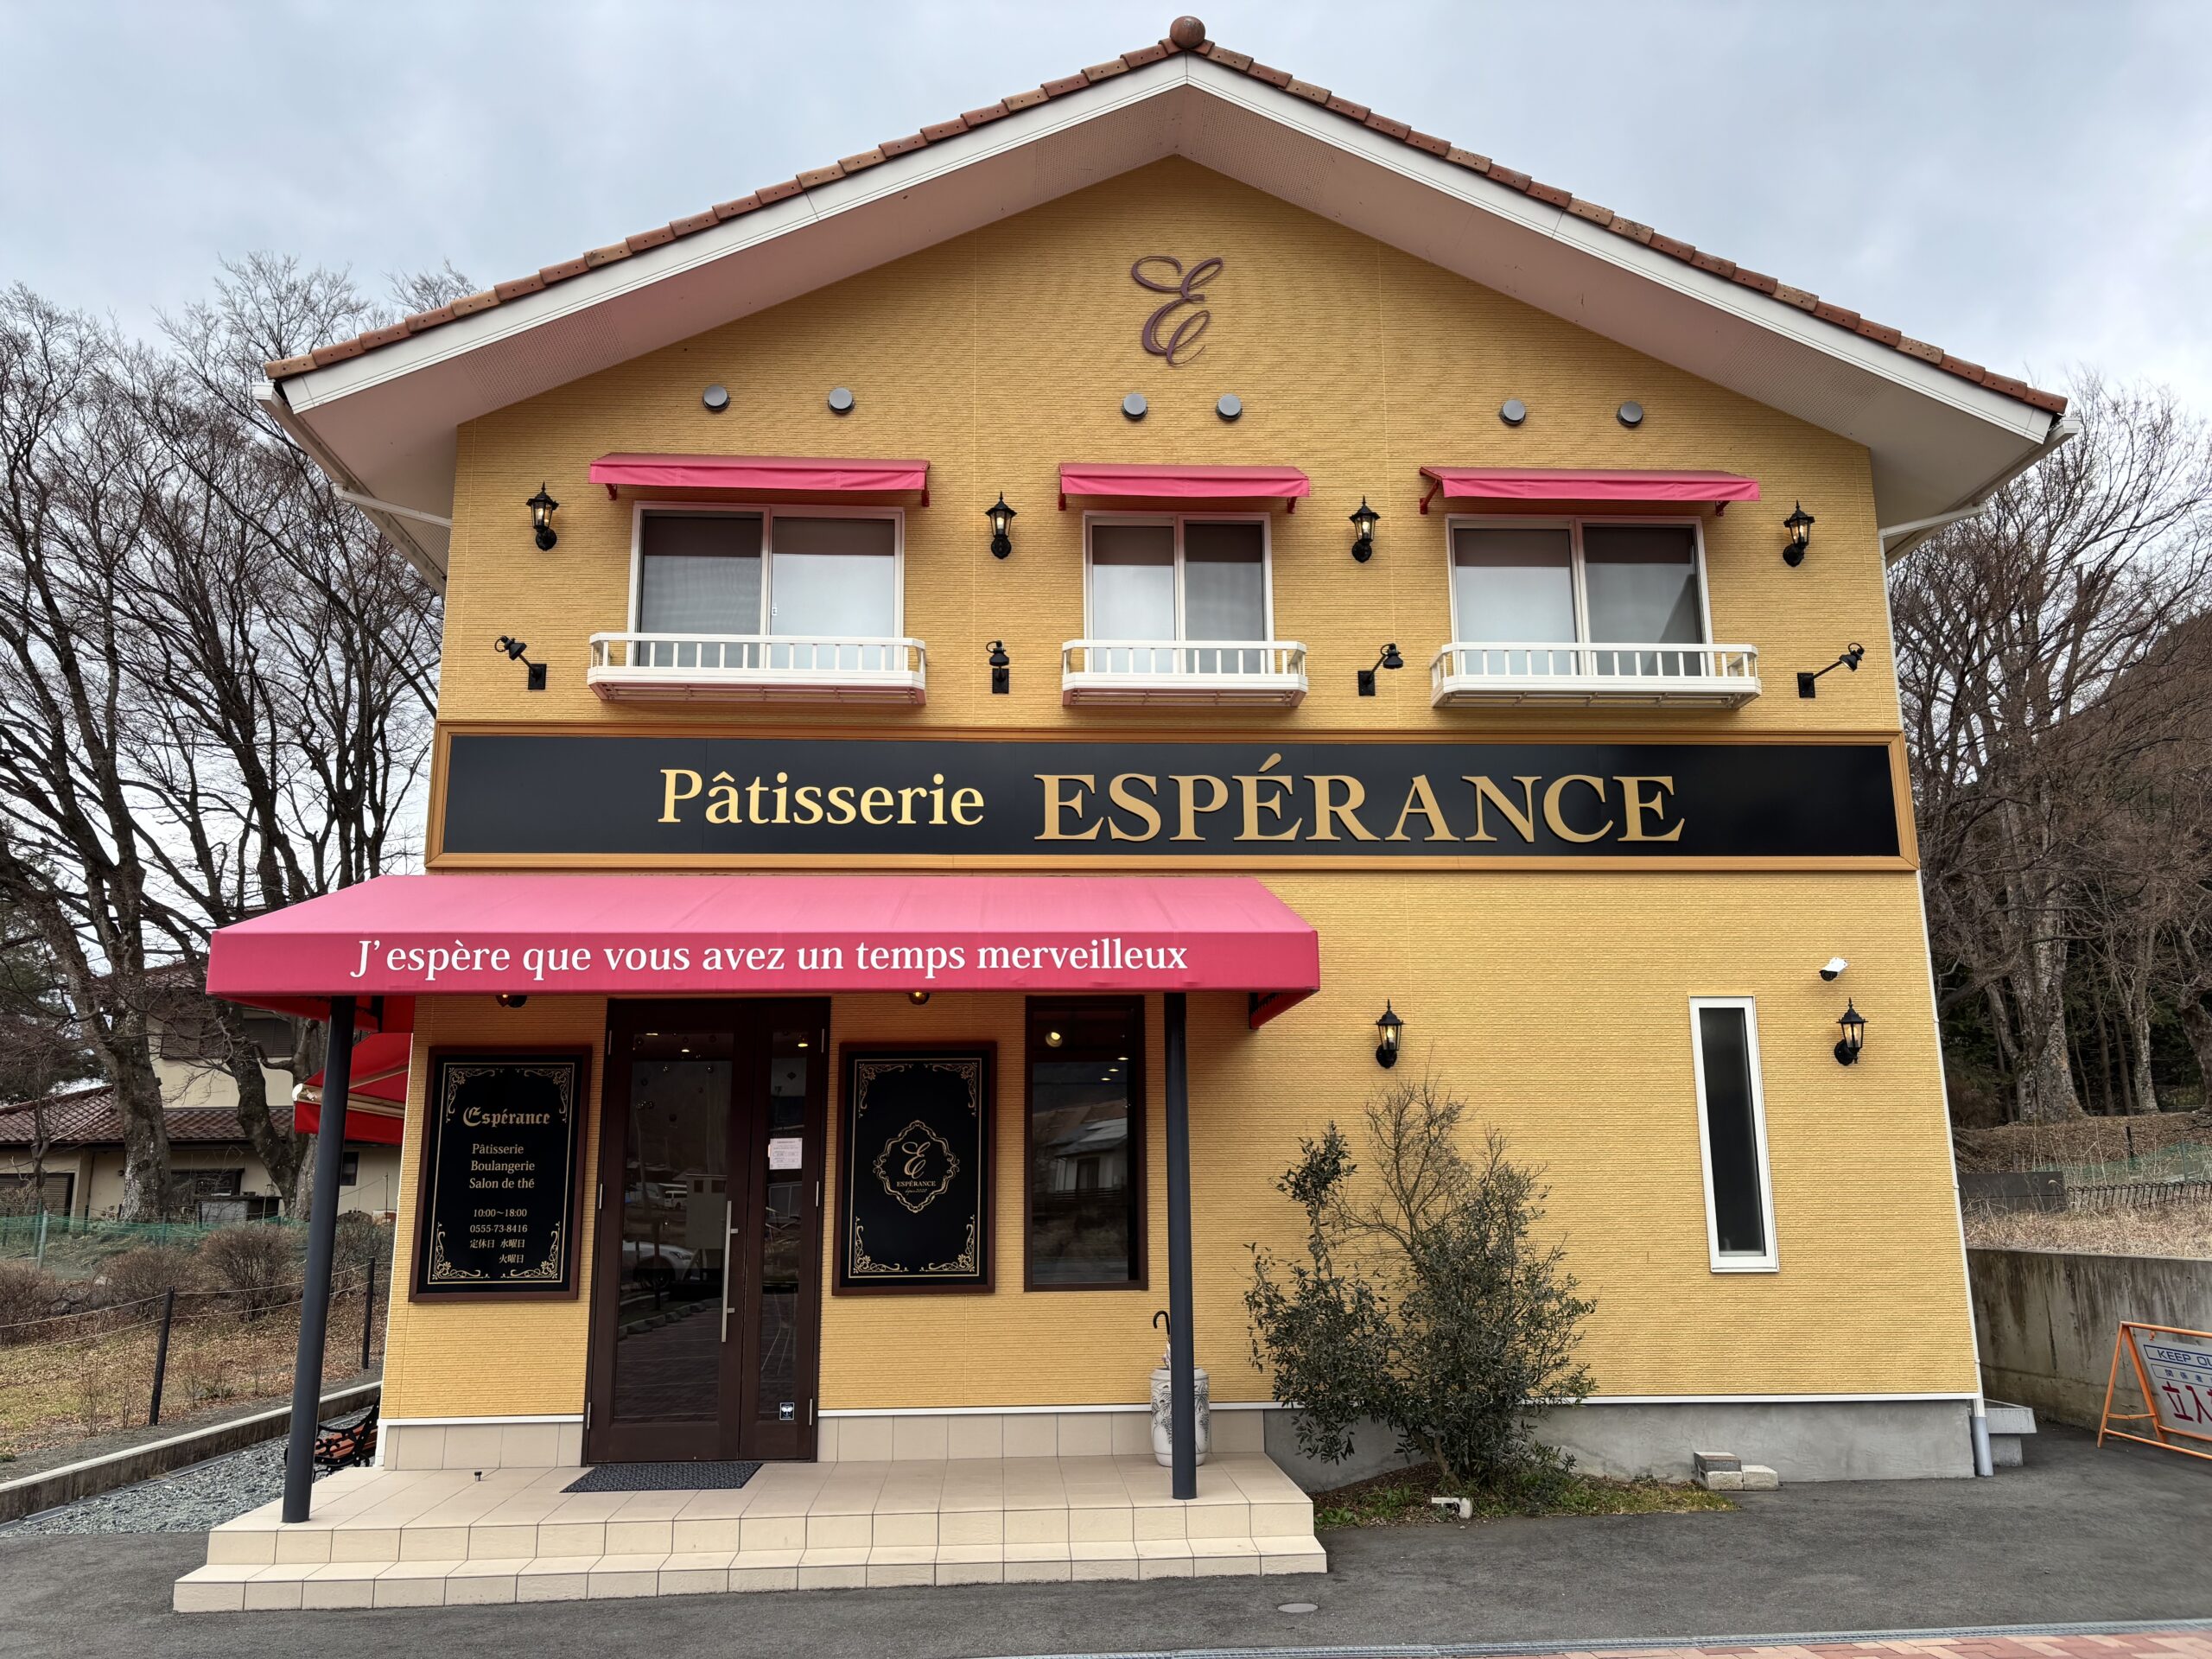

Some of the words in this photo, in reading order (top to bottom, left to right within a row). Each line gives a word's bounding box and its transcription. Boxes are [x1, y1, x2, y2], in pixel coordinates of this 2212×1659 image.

[1131, 255, 1224, 367] E
[658, 768, 985, 825] Pâtisserie
[1034, 753, 1686, 843] ESPÉRANCE
[522, 947, 592, 981] que
[603, 946, 690, 971] vous
[702, 945, 785, 971] avez
[798, 946, 844, 970] un
[855, 941, 966, 979] temps
[976, 938, 1188, 970] merveilleux
[462, 1106, 551, 1128] Espérance
[471, 1143, 524, 1155] Pâtisserie
[470, 1160, 536, 1174] Boulangerie
[468, 1177, 499, 1190] Salon
[501, 1177, 515, 1190] de
[517, 1177, 536, 1190] thé
[469, 1224, 529, 1234] 0555-73-8416
[469, 1238, 496, 1249] 定休日
[499, 1238, 525, 1249] 水曜日
[499, 1254, 525, 1264] 火曜日
[2157, 1349, 2192, 1363] KEEP
[2164, 1369, 2212, 1383] 関係者
[2162, 1381, 2212, 1425] 立入
